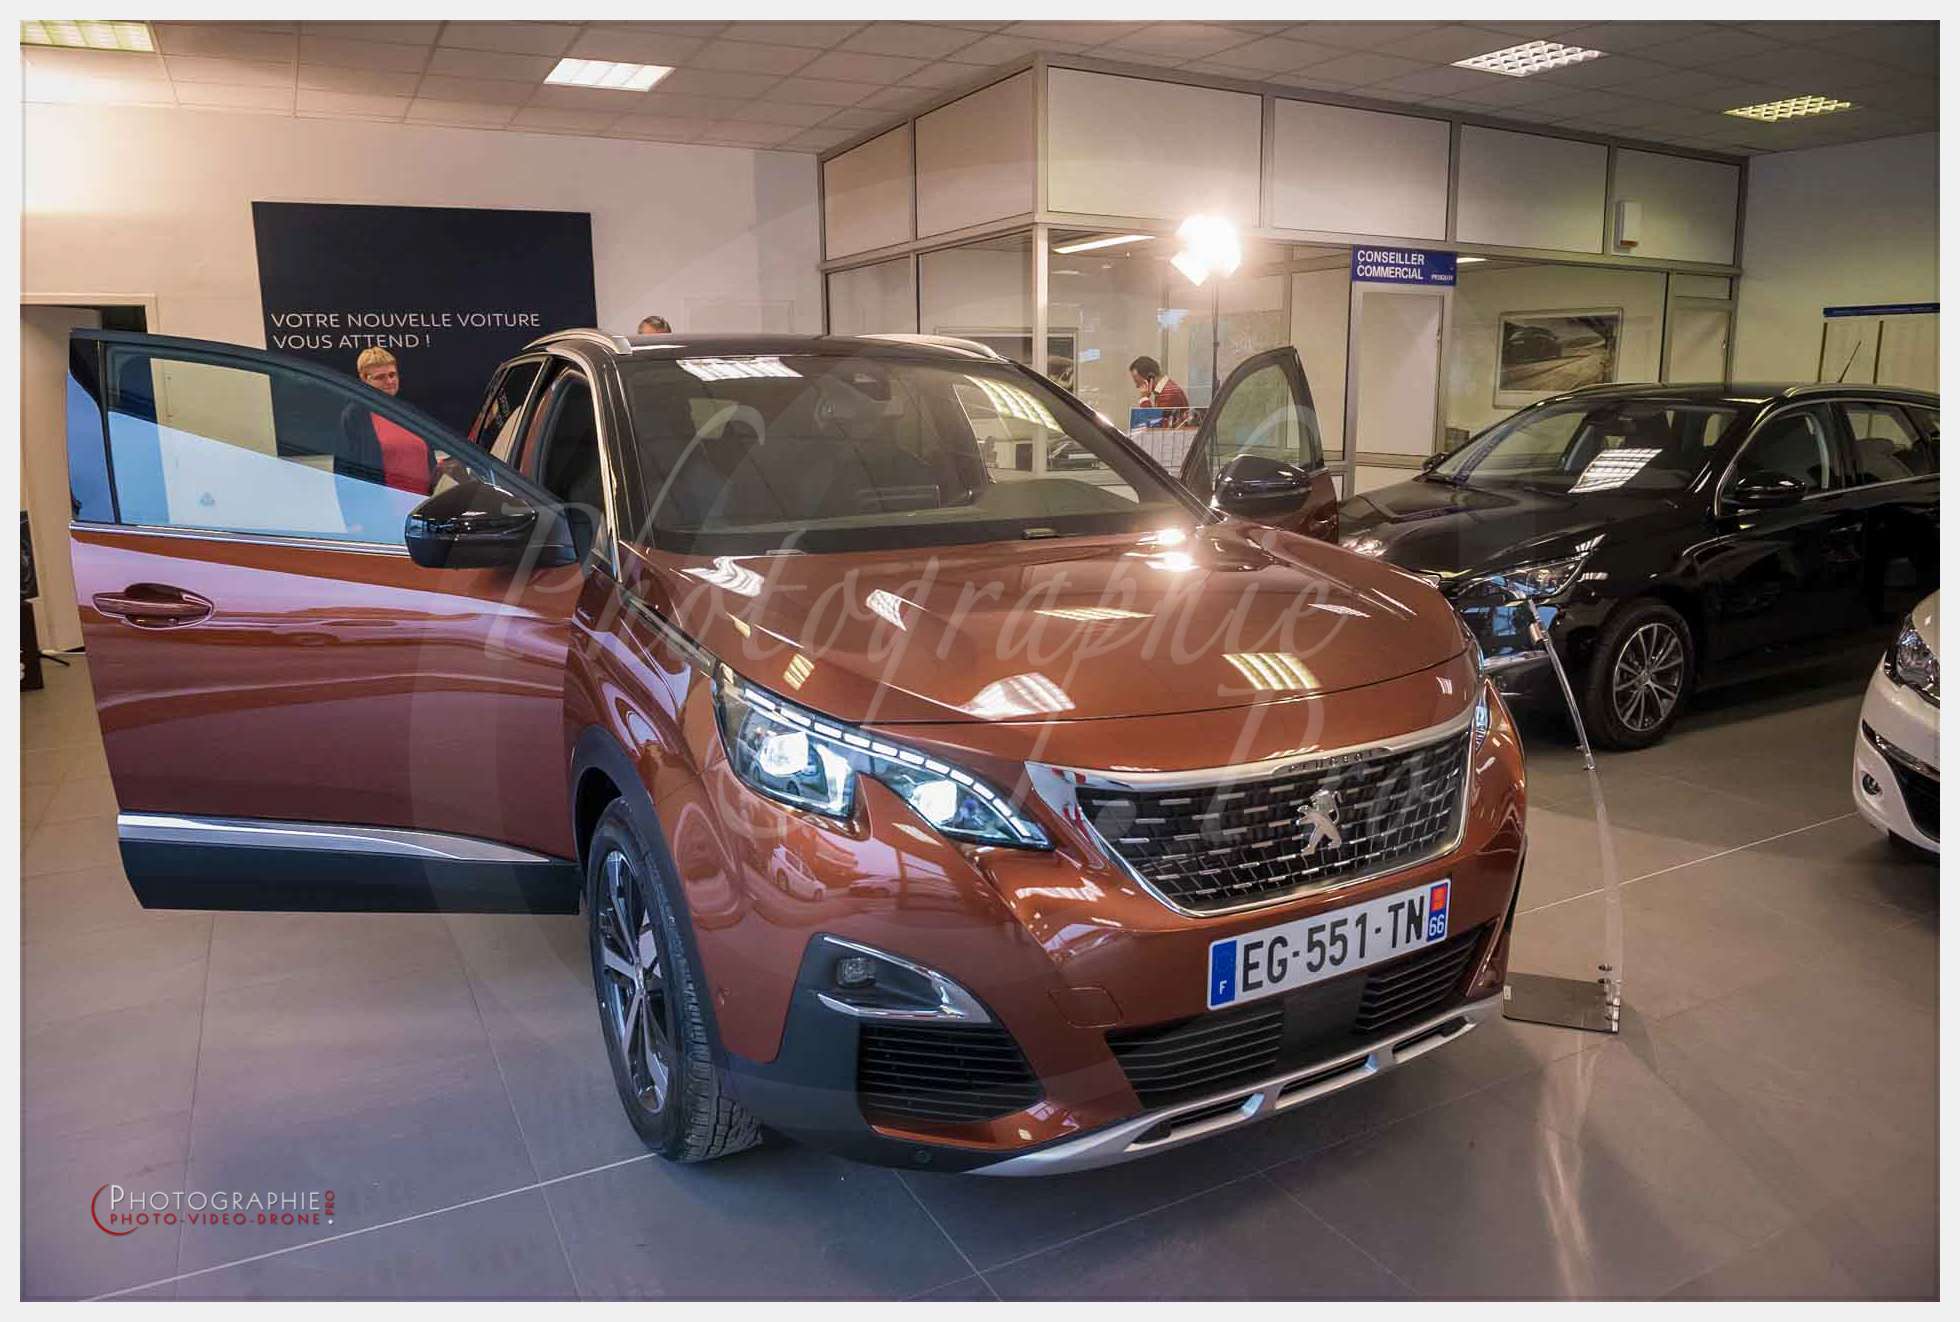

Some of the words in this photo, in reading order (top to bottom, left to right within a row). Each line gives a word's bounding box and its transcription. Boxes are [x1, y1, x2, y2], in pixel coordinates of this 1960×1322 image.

[1357, 250, 1425, 265] CONSEILLER
[1356, 264, 1424, 280] COMMERCIAL
[271, 313, 341, 328] VOTRE
[348, 313, 453, 328] NOUVELLE
[456, 313, 541, 327] VOITURE
[273, 335, 333, 349] VOUS
[339, 334, 420, 349] ATTEND
[425, 334, 431, 348] !
[1428, 914, 1445, 937] 66
[1242, 895, 1425, 993] EG-551-TN
[1219, 979, 1227, 995] F
